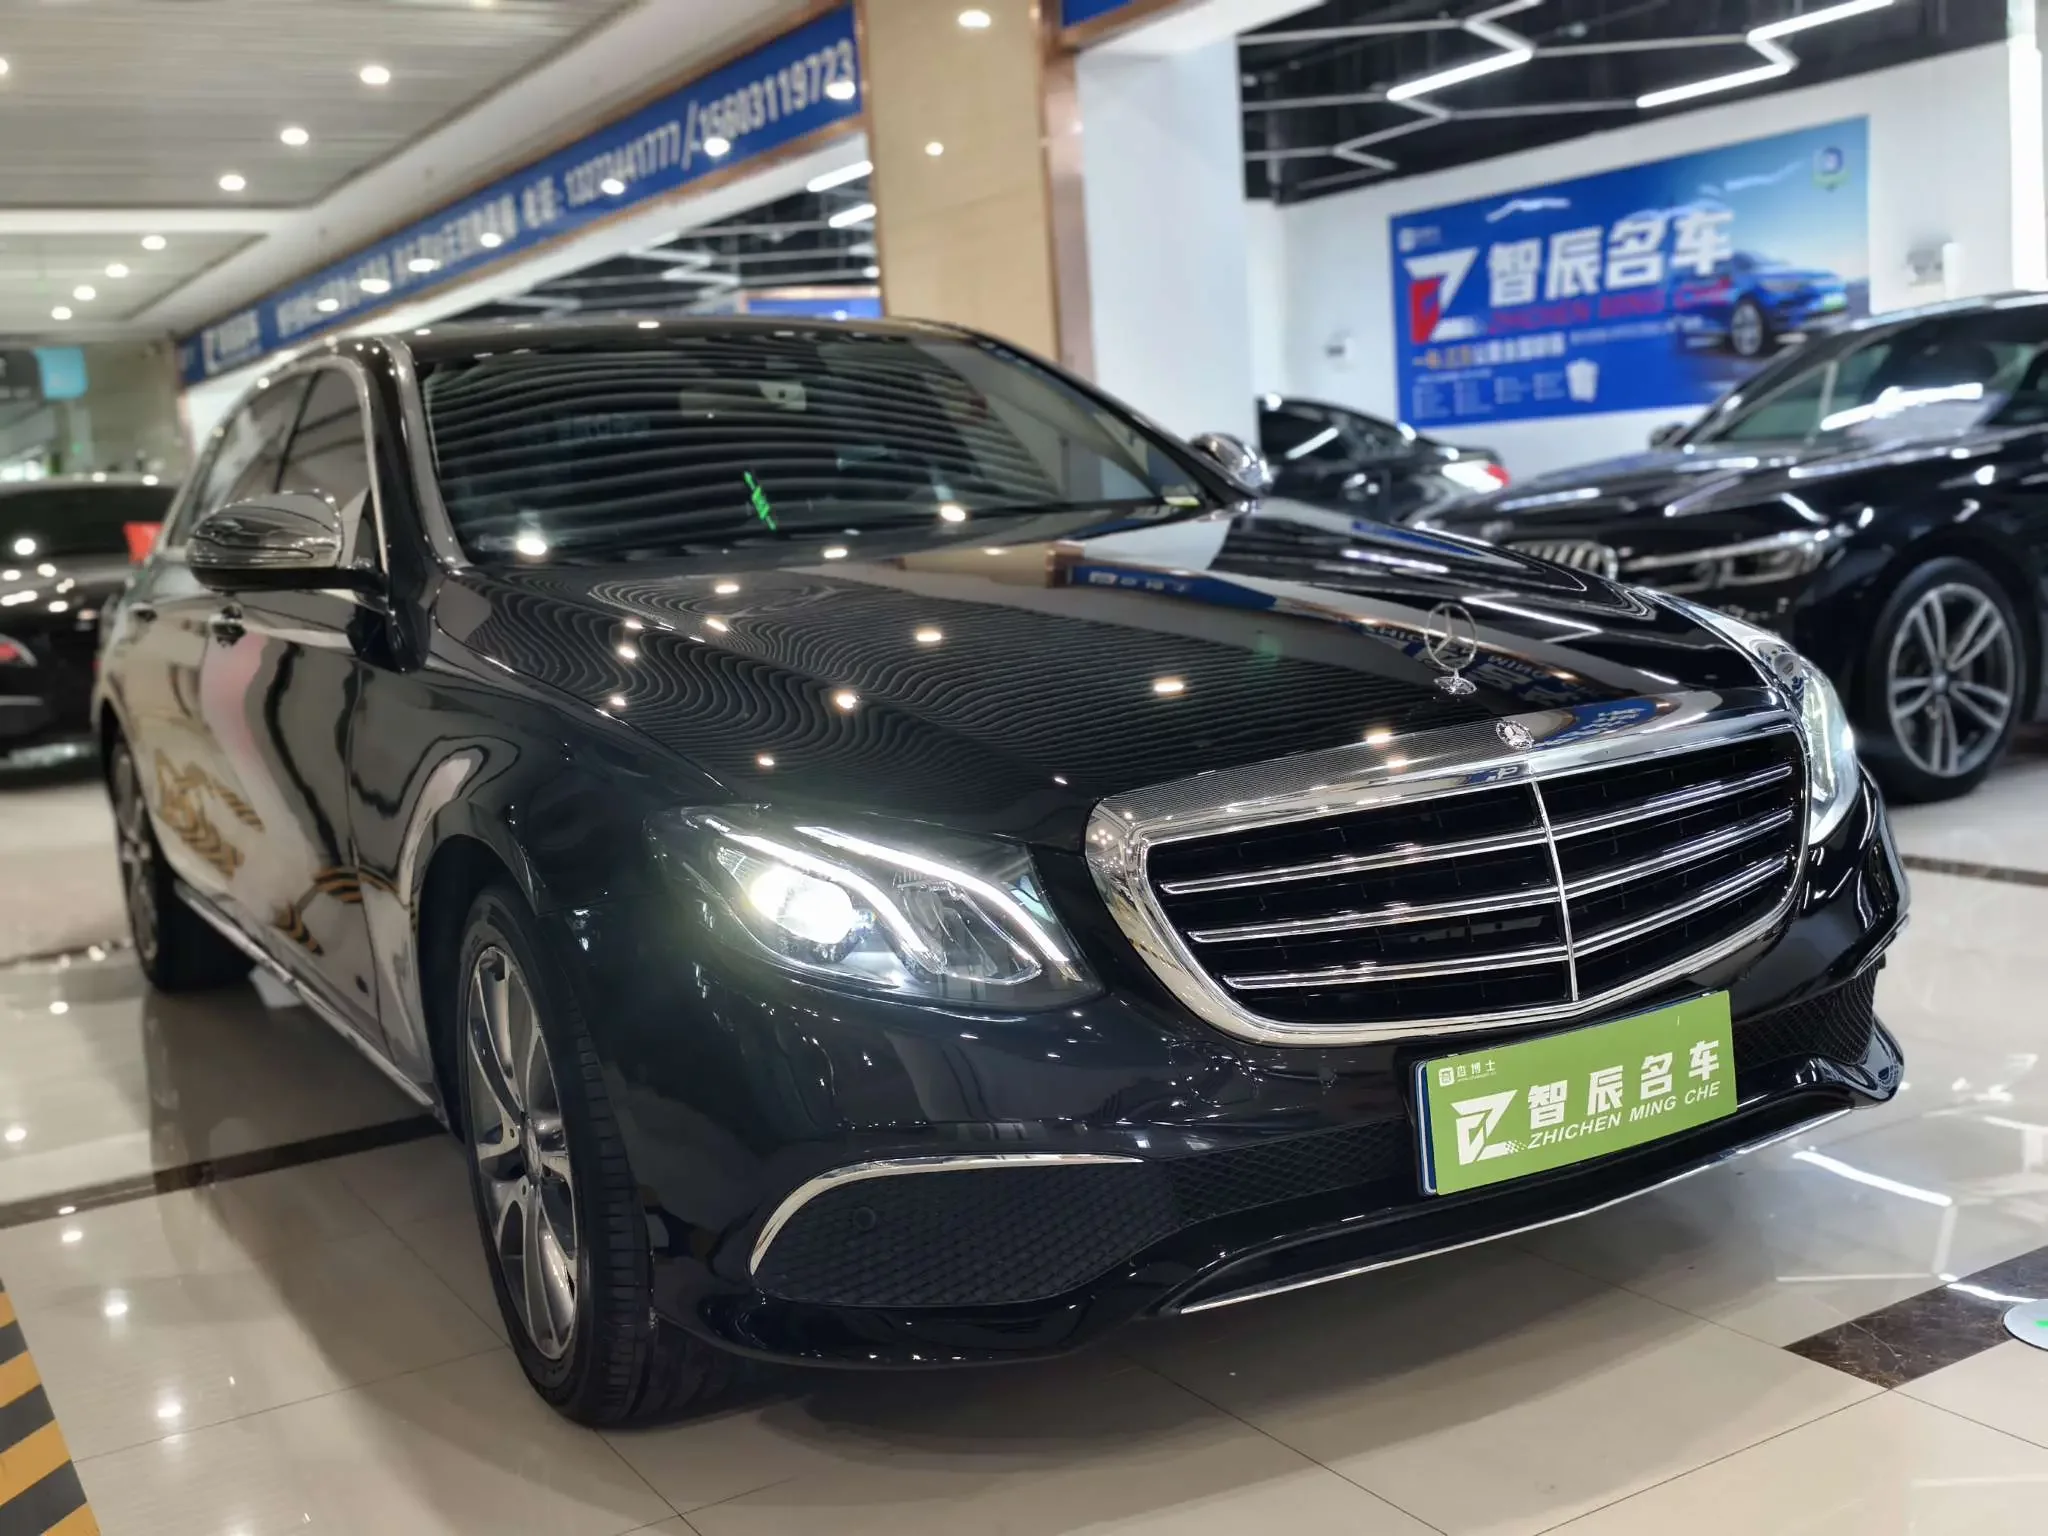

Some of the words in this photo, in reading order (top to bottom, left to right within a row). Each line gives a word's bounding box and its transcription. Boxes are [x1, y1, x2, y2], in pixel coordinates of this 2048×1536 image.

[1488, 210, 1734, 307] 智辰名车
[1527, 1039, 1720, 1130] 智辰名车
[1527, 1112, 1622, 1150] ZHICHEN
[1629, 1096, 1678, 1122] MING
[1684, 1081, 1721, 1105] CHE
